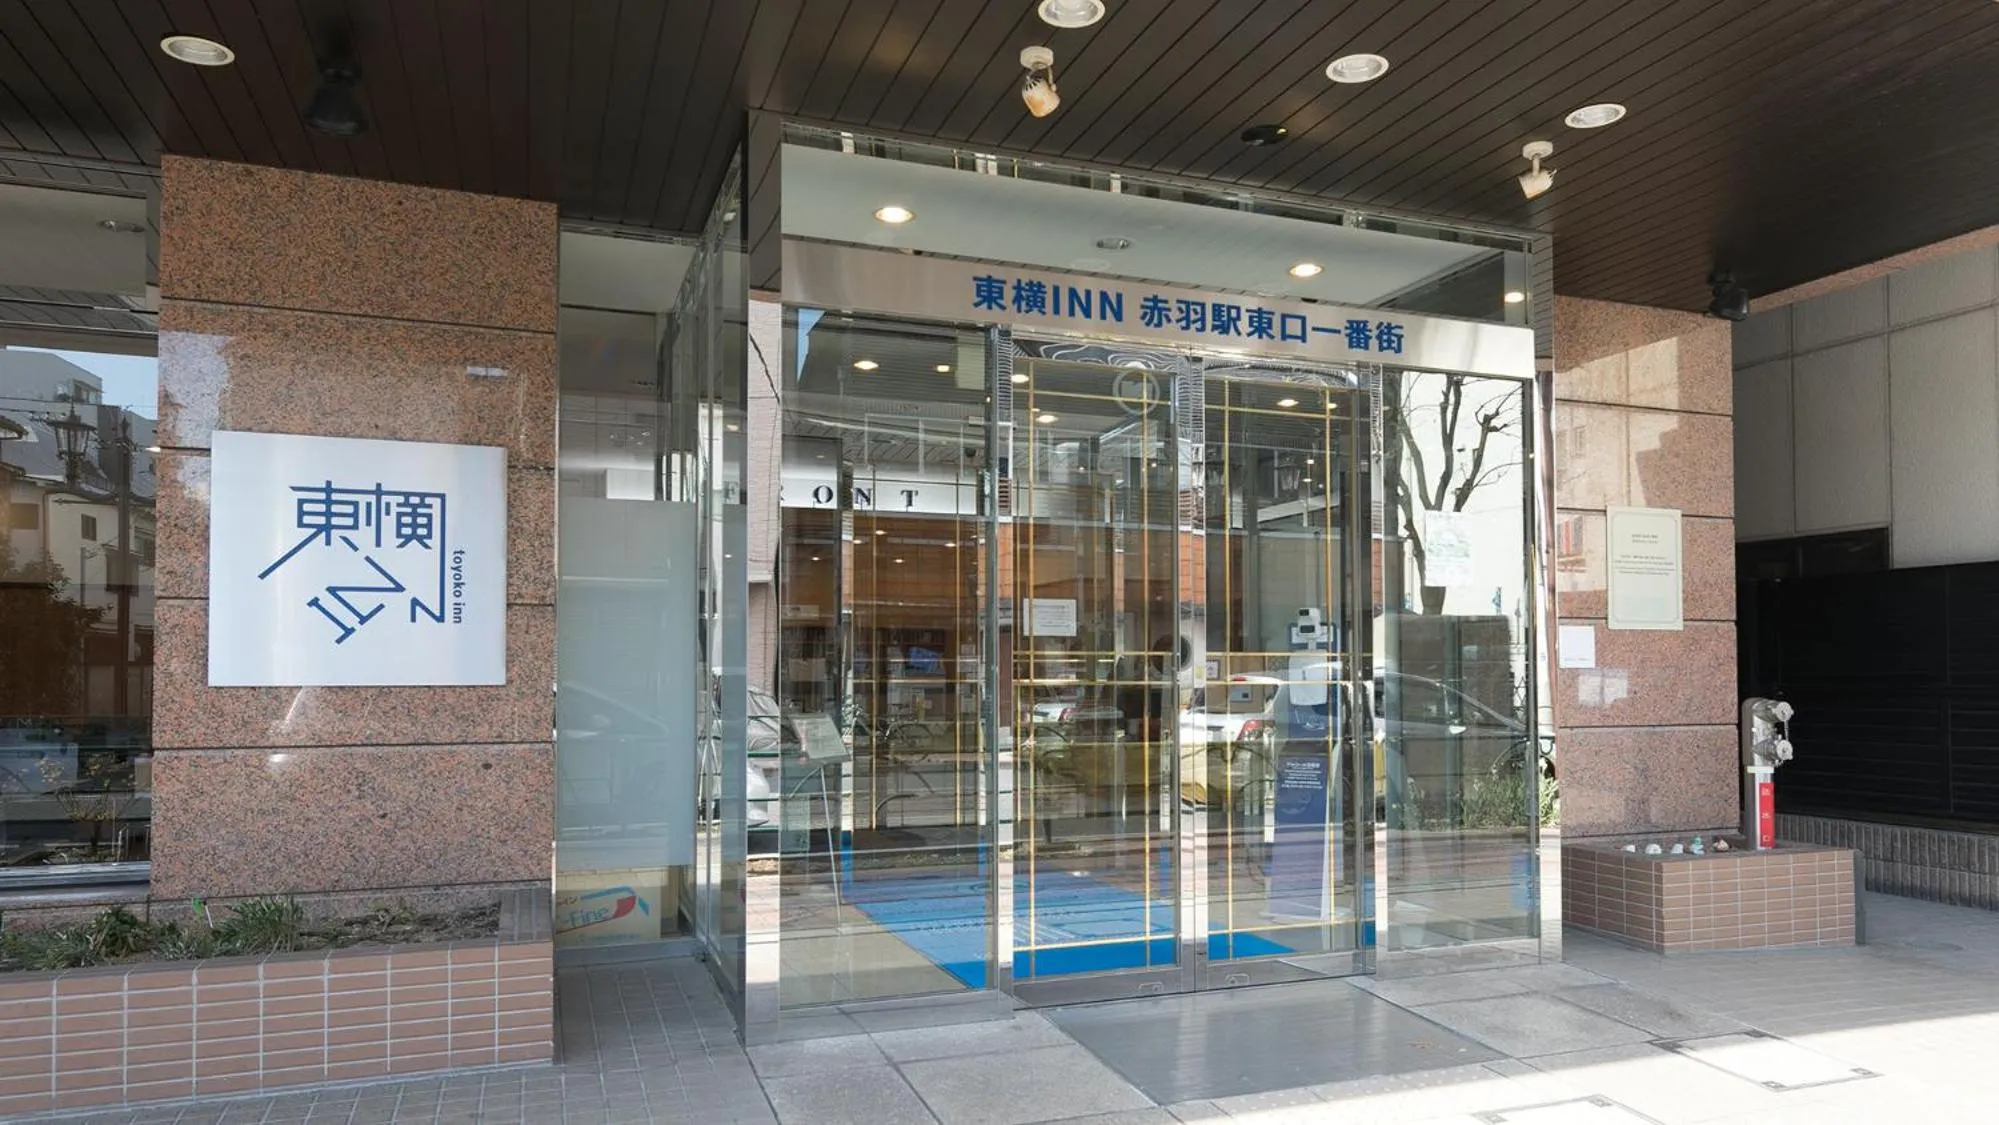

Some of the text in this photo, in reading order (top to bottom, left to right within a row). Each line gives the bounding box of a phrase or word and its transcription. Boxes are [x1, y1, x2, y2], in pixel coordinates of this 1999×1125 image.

[972, 275, 1405, 354] 東横INN 赤羽駅東口一番街
[450, 550, 465, 625] toyoko inn
